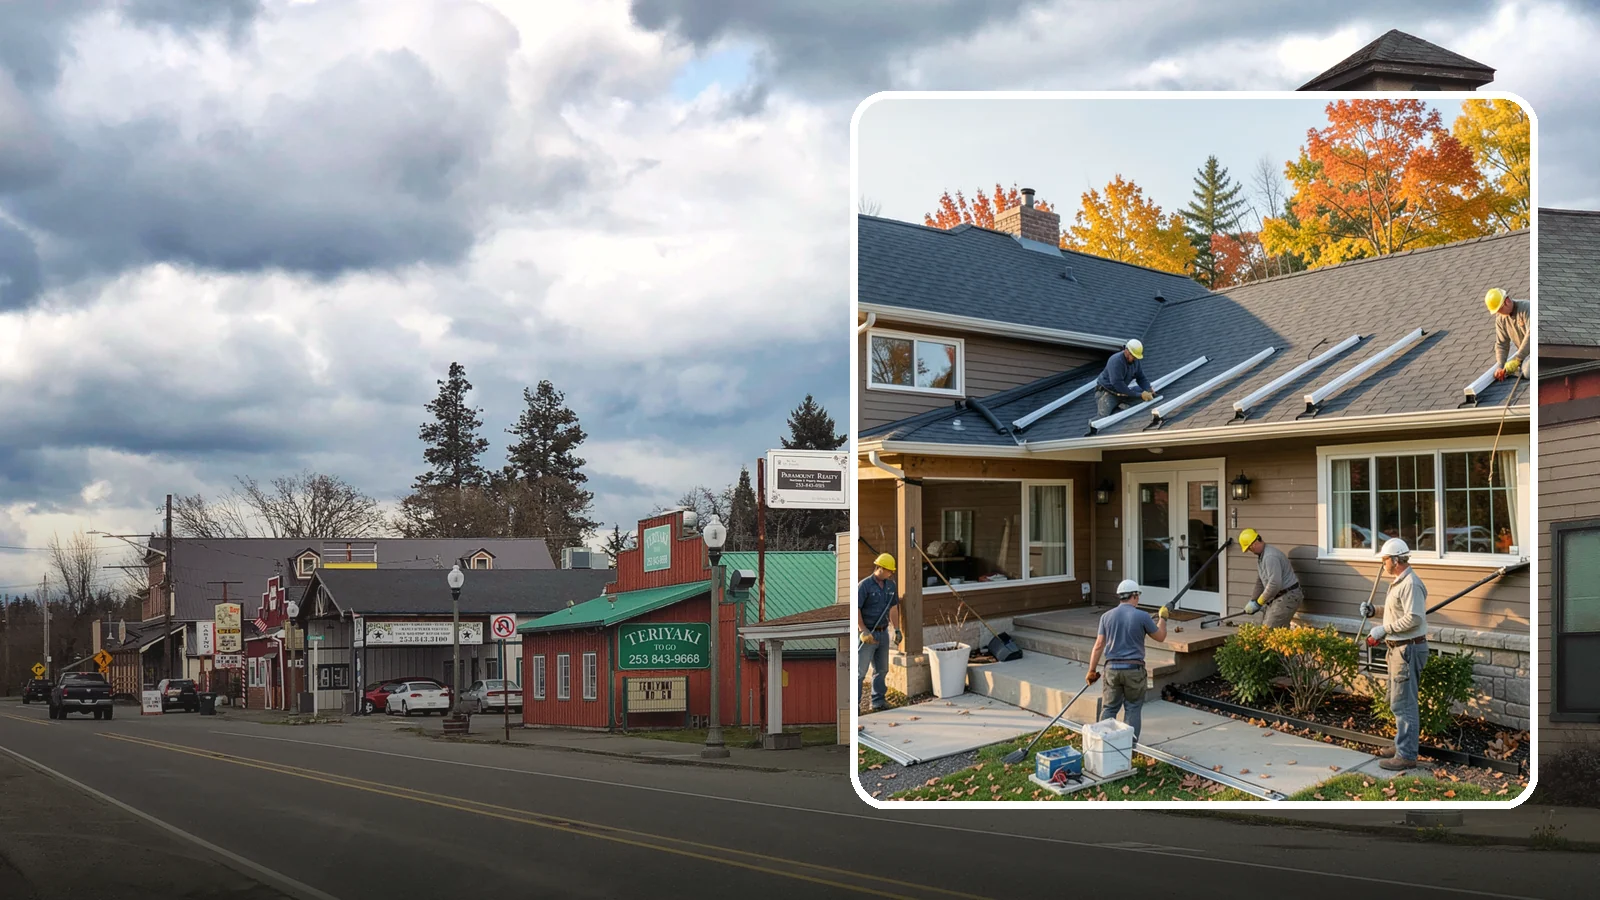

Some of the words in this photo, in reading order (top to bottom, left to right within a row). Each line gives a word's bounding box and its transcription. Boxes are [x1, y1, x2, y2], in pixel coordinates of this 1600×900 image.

[625, 628, 702, 646] TERIYAKI
[628, 655, 648, 664] 253
[652, 654, 700, 664] 843-9668
